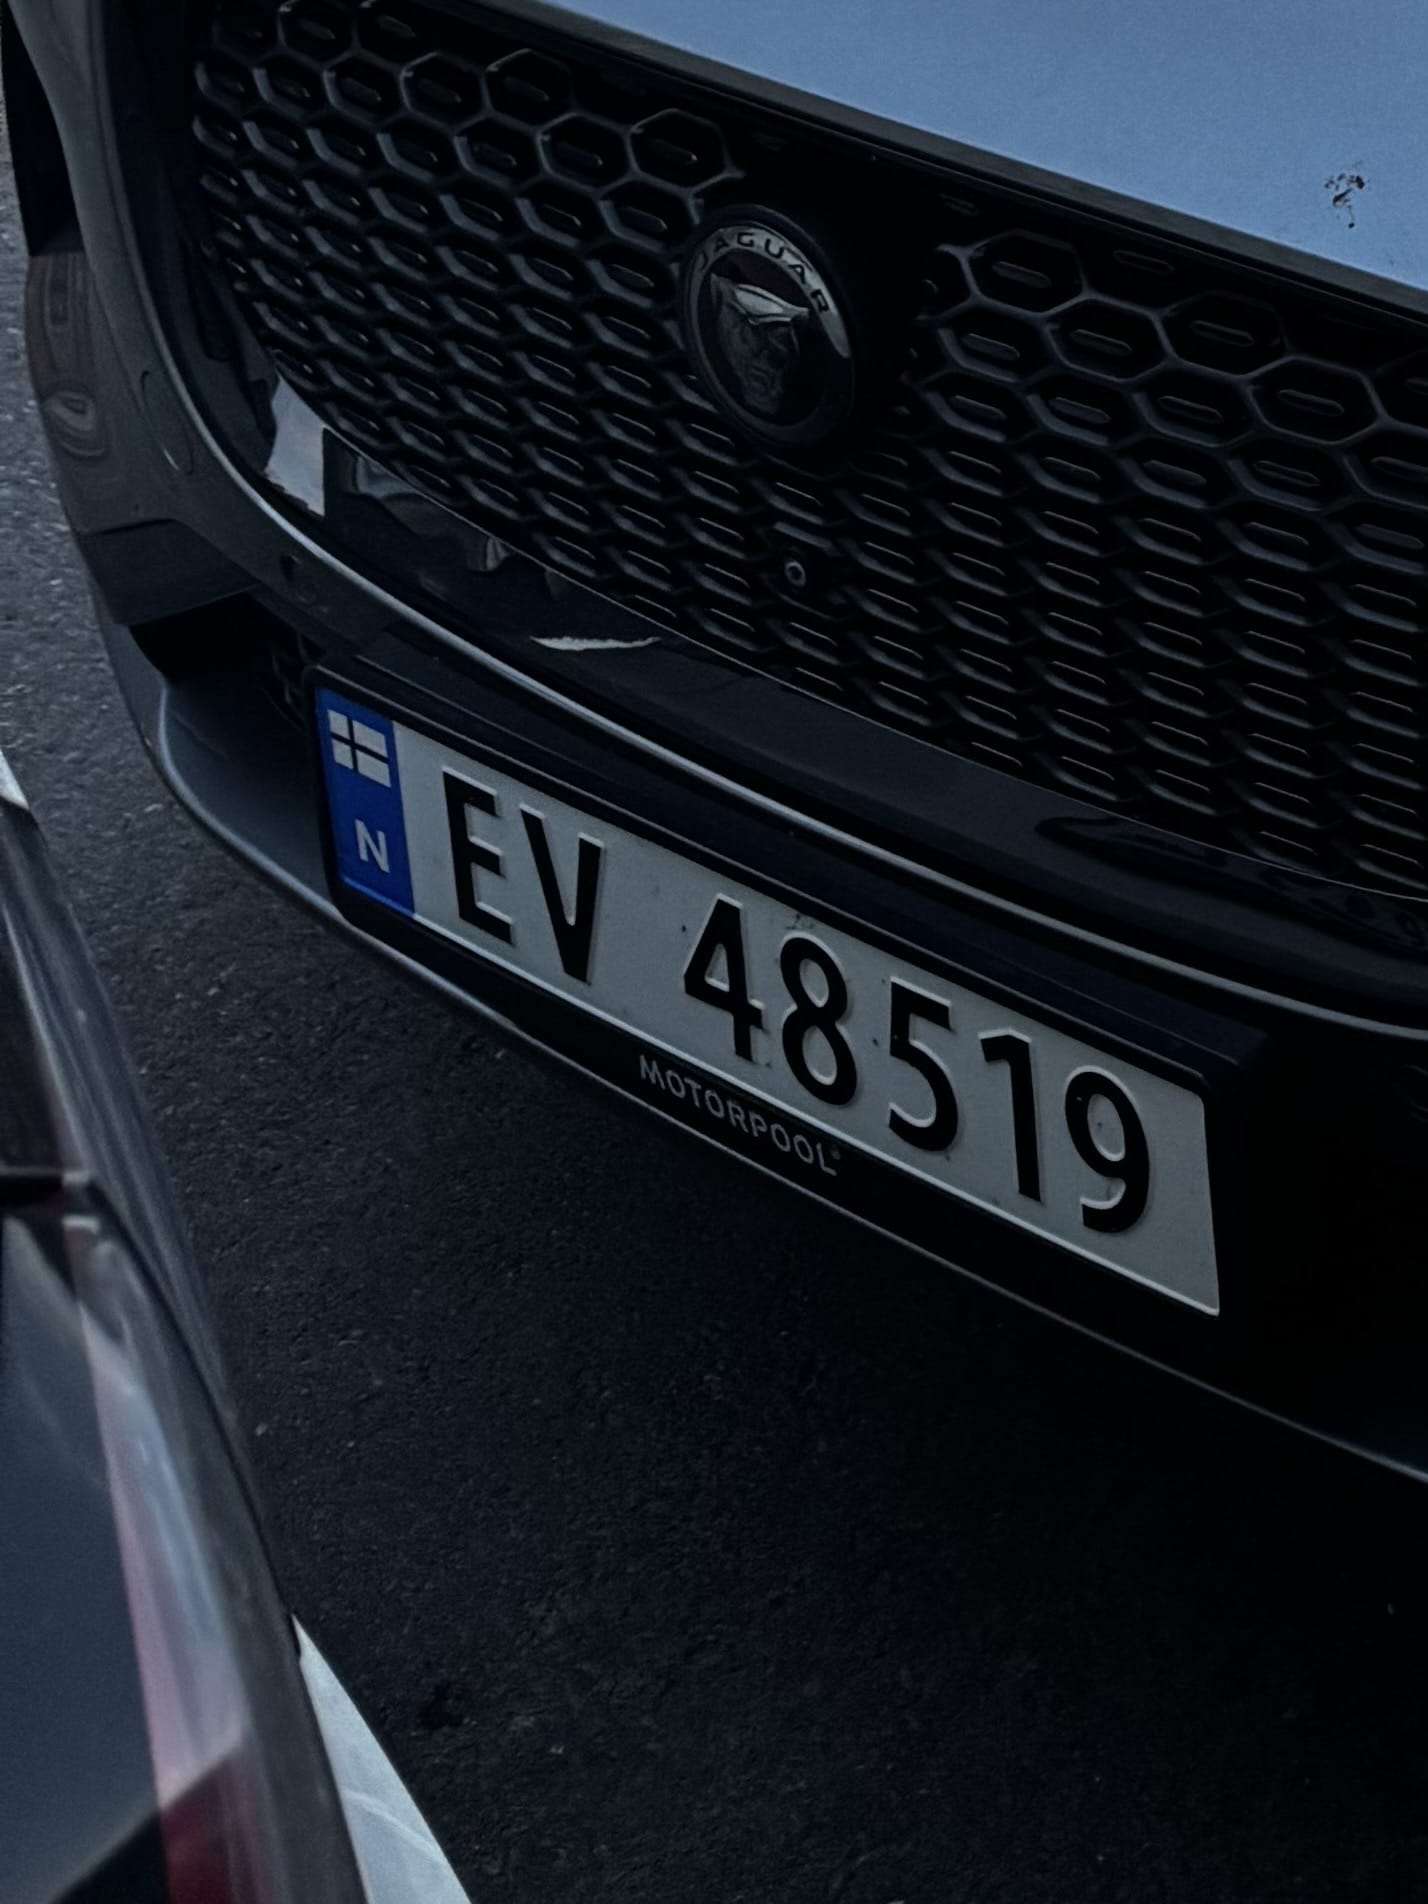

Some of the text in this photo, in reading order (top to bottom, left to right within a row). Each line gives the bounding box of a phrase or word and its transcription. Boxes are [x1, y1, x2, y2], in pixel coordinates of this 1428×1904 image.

[699, 231, 830, 313] JAGUAR
[355, 819, 390, 873] N
[441, 767, 1151, 1234] EV 48519
[639, 1054, 838, 1176] MOTORPOOL
